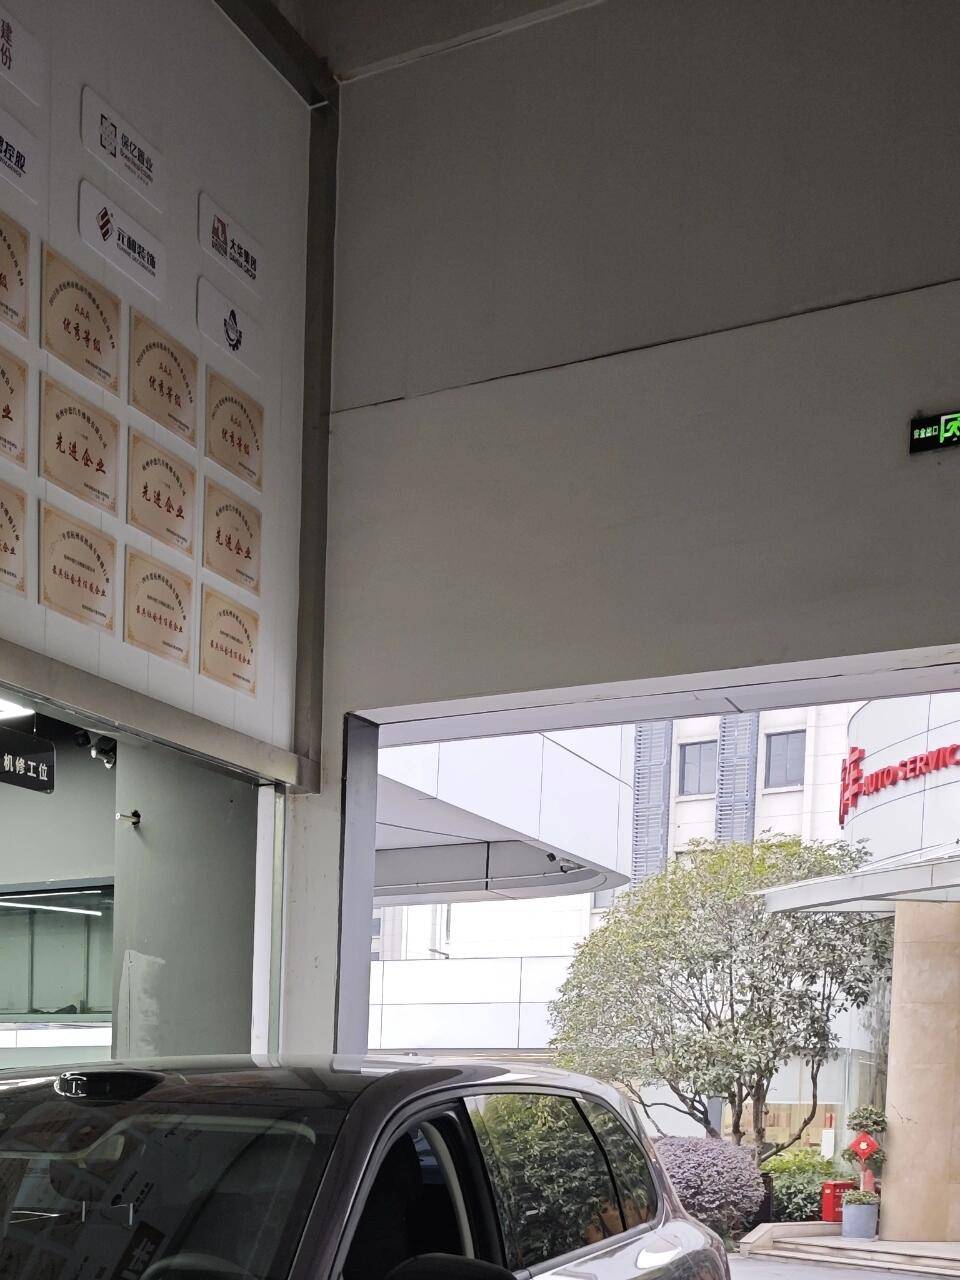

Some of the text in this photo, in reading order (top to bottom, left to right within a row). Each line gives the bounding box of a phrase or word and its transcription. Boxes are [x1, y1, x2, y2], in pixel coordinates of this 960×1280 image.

[74, 302, 91, 323] AAA
[55, 431, 107, 475] 先进企业
[4, 752, 49, 781] 机修工位
[862, 765, 898, 797] AUTO
